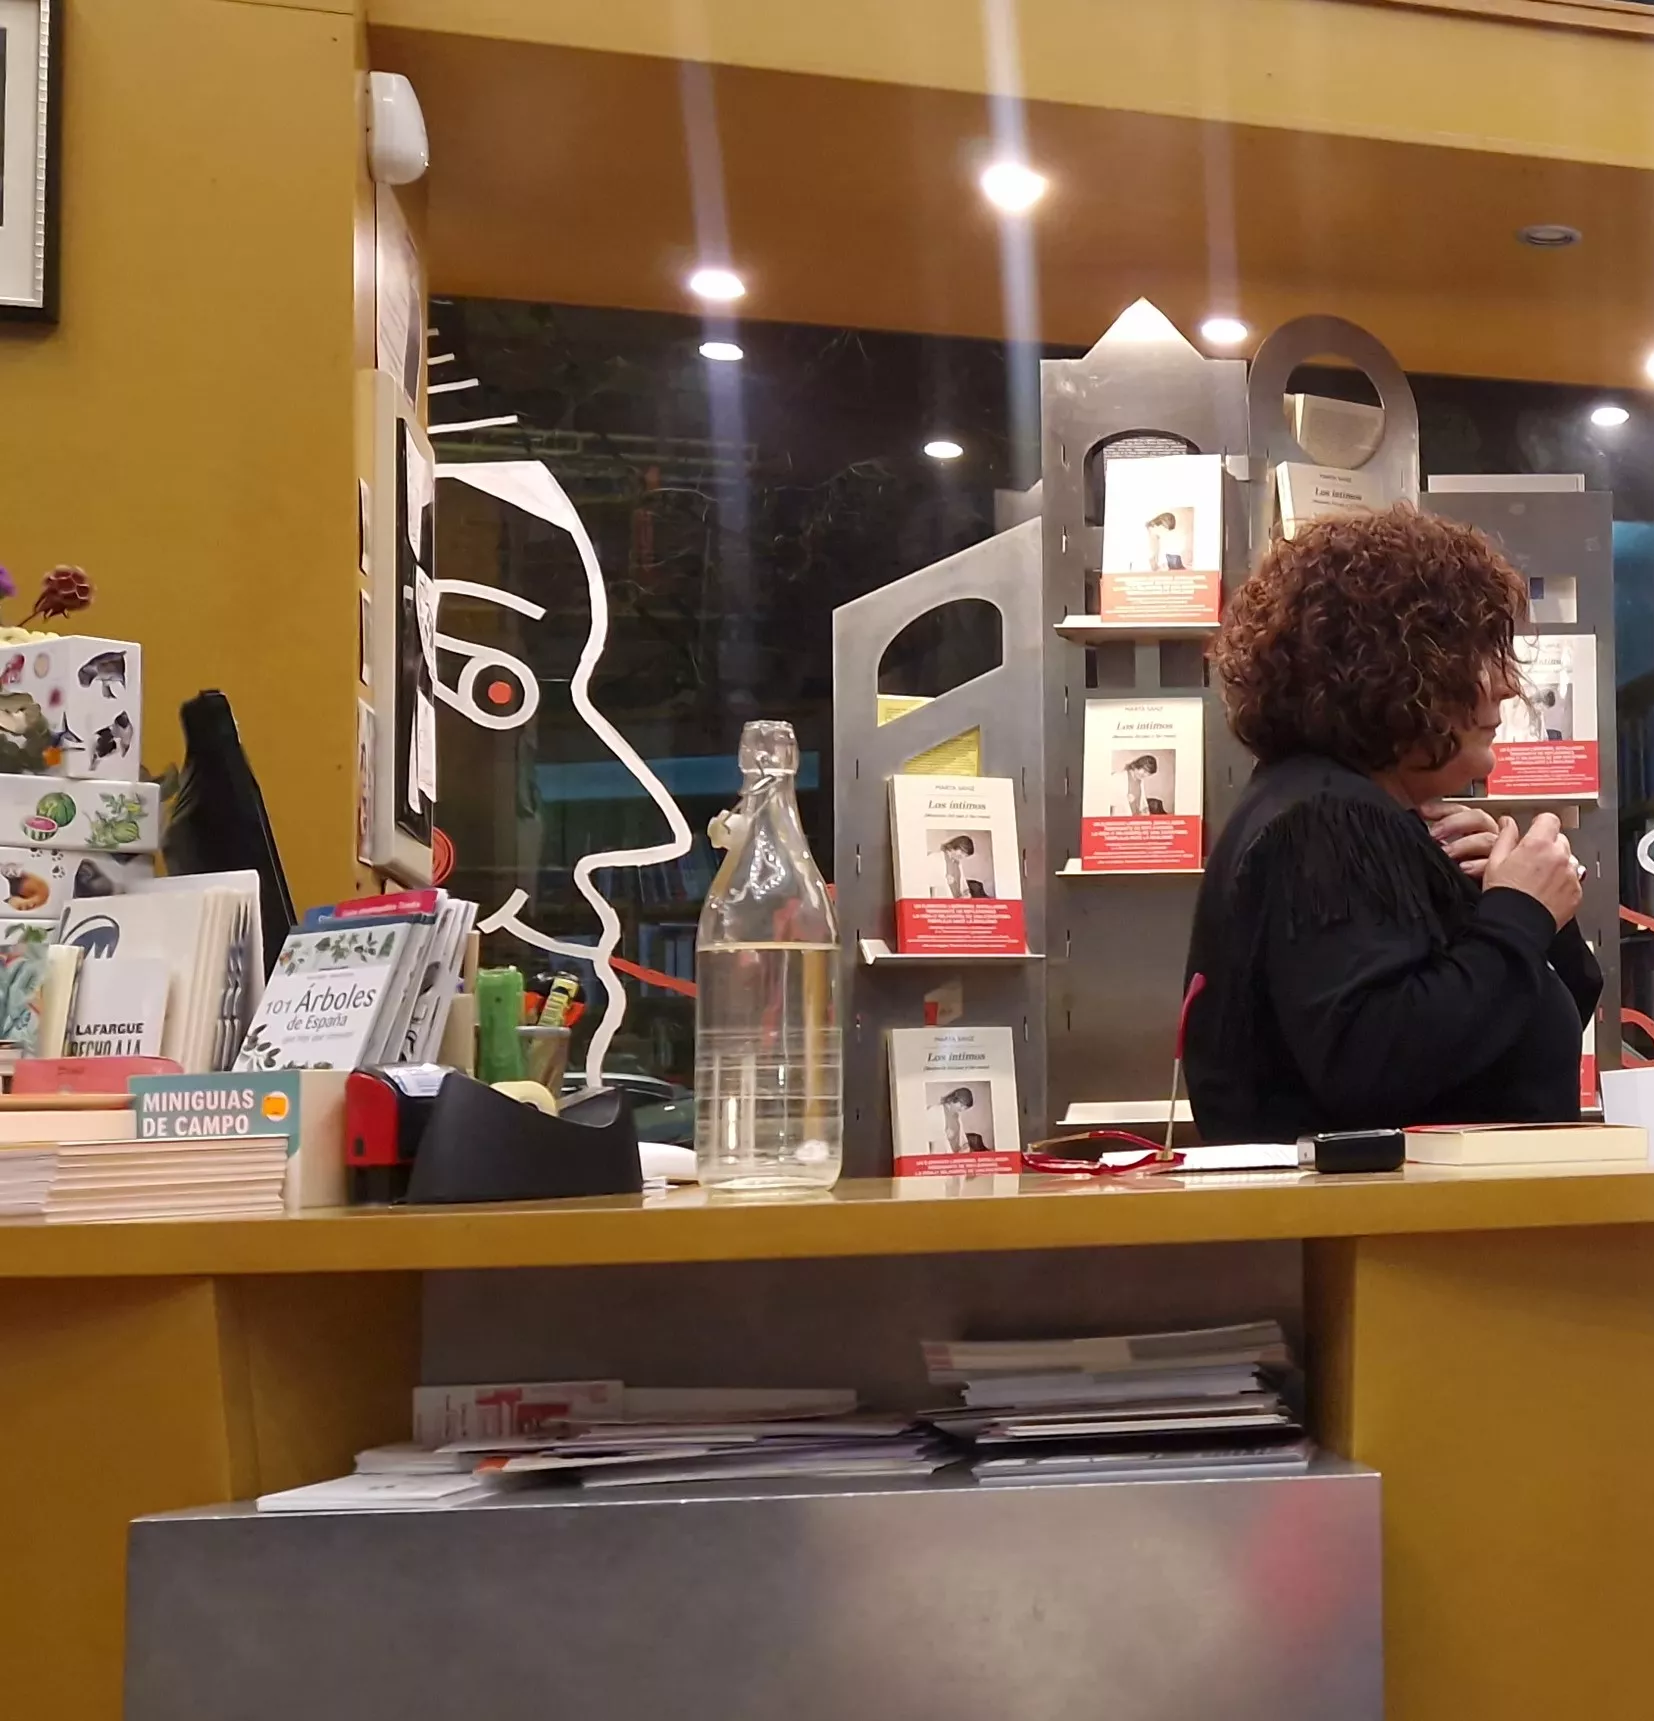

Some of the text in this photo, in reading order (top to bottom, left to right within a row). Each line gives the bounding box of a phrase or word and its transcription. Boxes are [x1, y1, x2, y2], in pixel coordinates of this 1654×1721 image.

[1116, 721, 1134, 731] Los
[928, 799, 947, 810] Los
[265, 982, 377, 1015] 101 Árboles
[75, 1022, 145, 1036] LAFARGUE
[286, 1013, 348, 1033] de España
[927, 1052, 946, 1062] Los
[142, 1090, 254, 1113] MINIGUIAS
[142, 1114, 250, 1138] DE CAMPO
